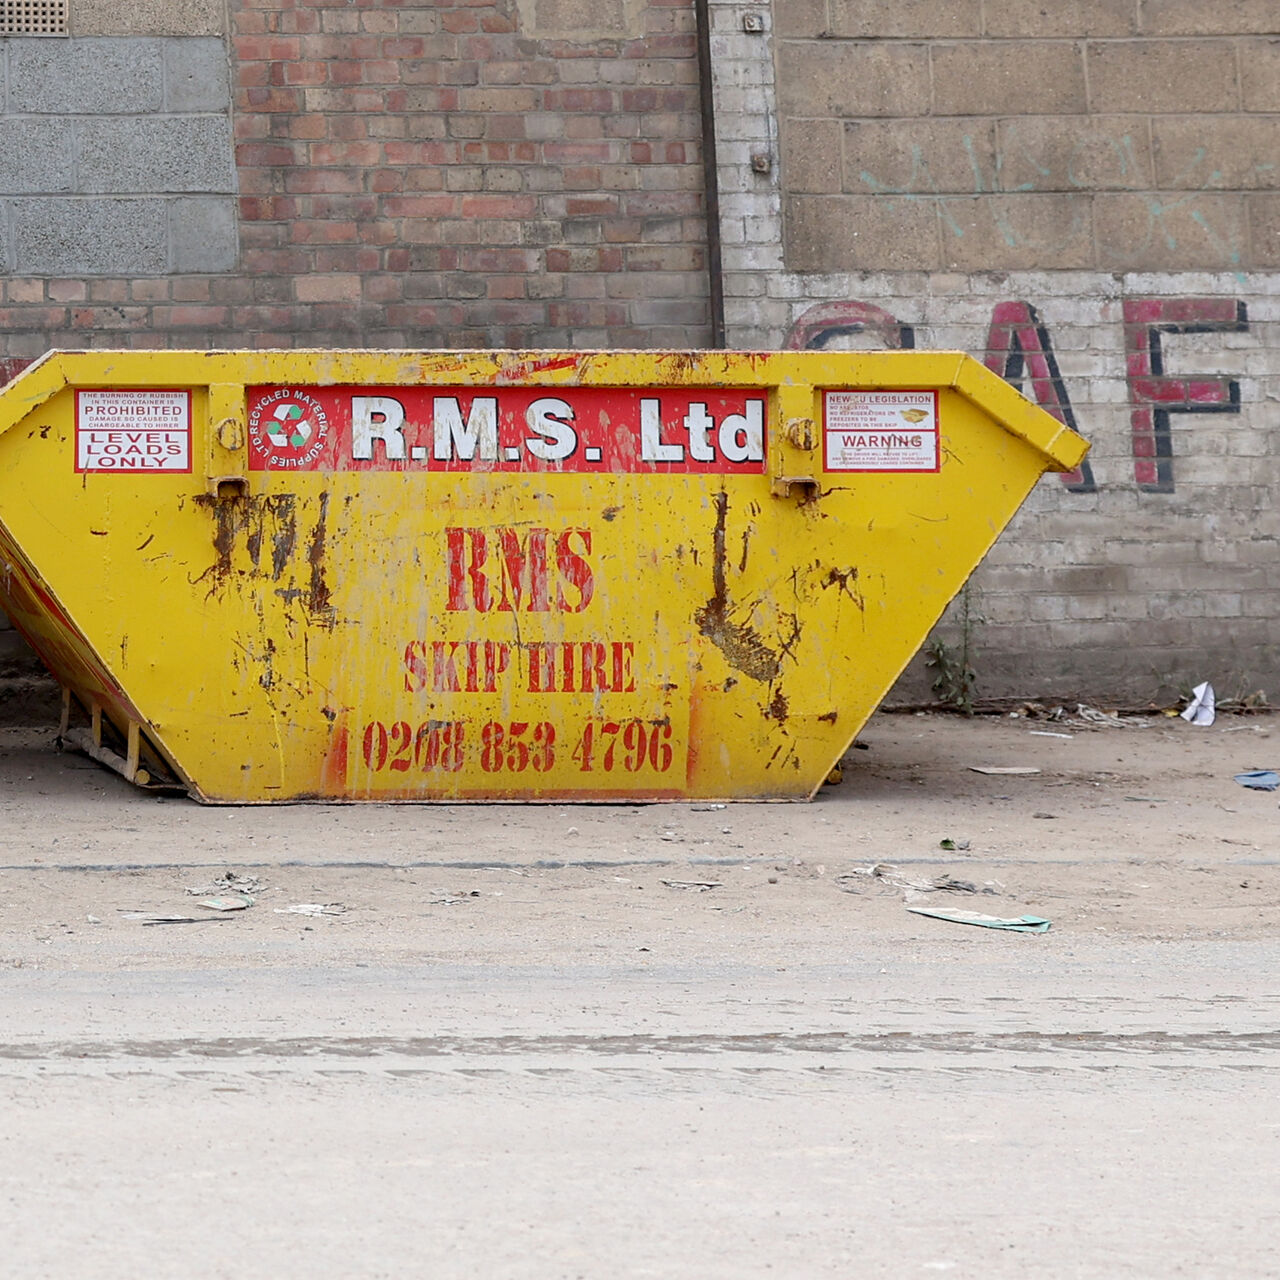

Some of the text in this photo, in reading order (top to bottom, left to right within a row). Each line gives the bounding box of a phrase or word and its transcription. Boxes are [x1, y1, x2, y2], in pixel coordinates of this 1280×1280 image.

[84, 406, 182, 416] PROHIBITED
[783, 300, 1249, 494] AF
[869, 395, 931, 403] LEGISLATION
[90, 433, 178, 443] LEVEL
[249, 389, 328, 467] RECYCLED MATERIAL SUPPLIES LTD
[351, 396, 764, 463] R.M.S. Ltd
[842, 435, 922, 447] WARNING
[87, 444, 182, 455] LOADS
[98, 456, 168, 467] ONLY
[445, 526, 594, 613] RMS
[404, 640, 637, 693] SKIP HIRE
[362, 719, 673, 773] 0208 853 4796
